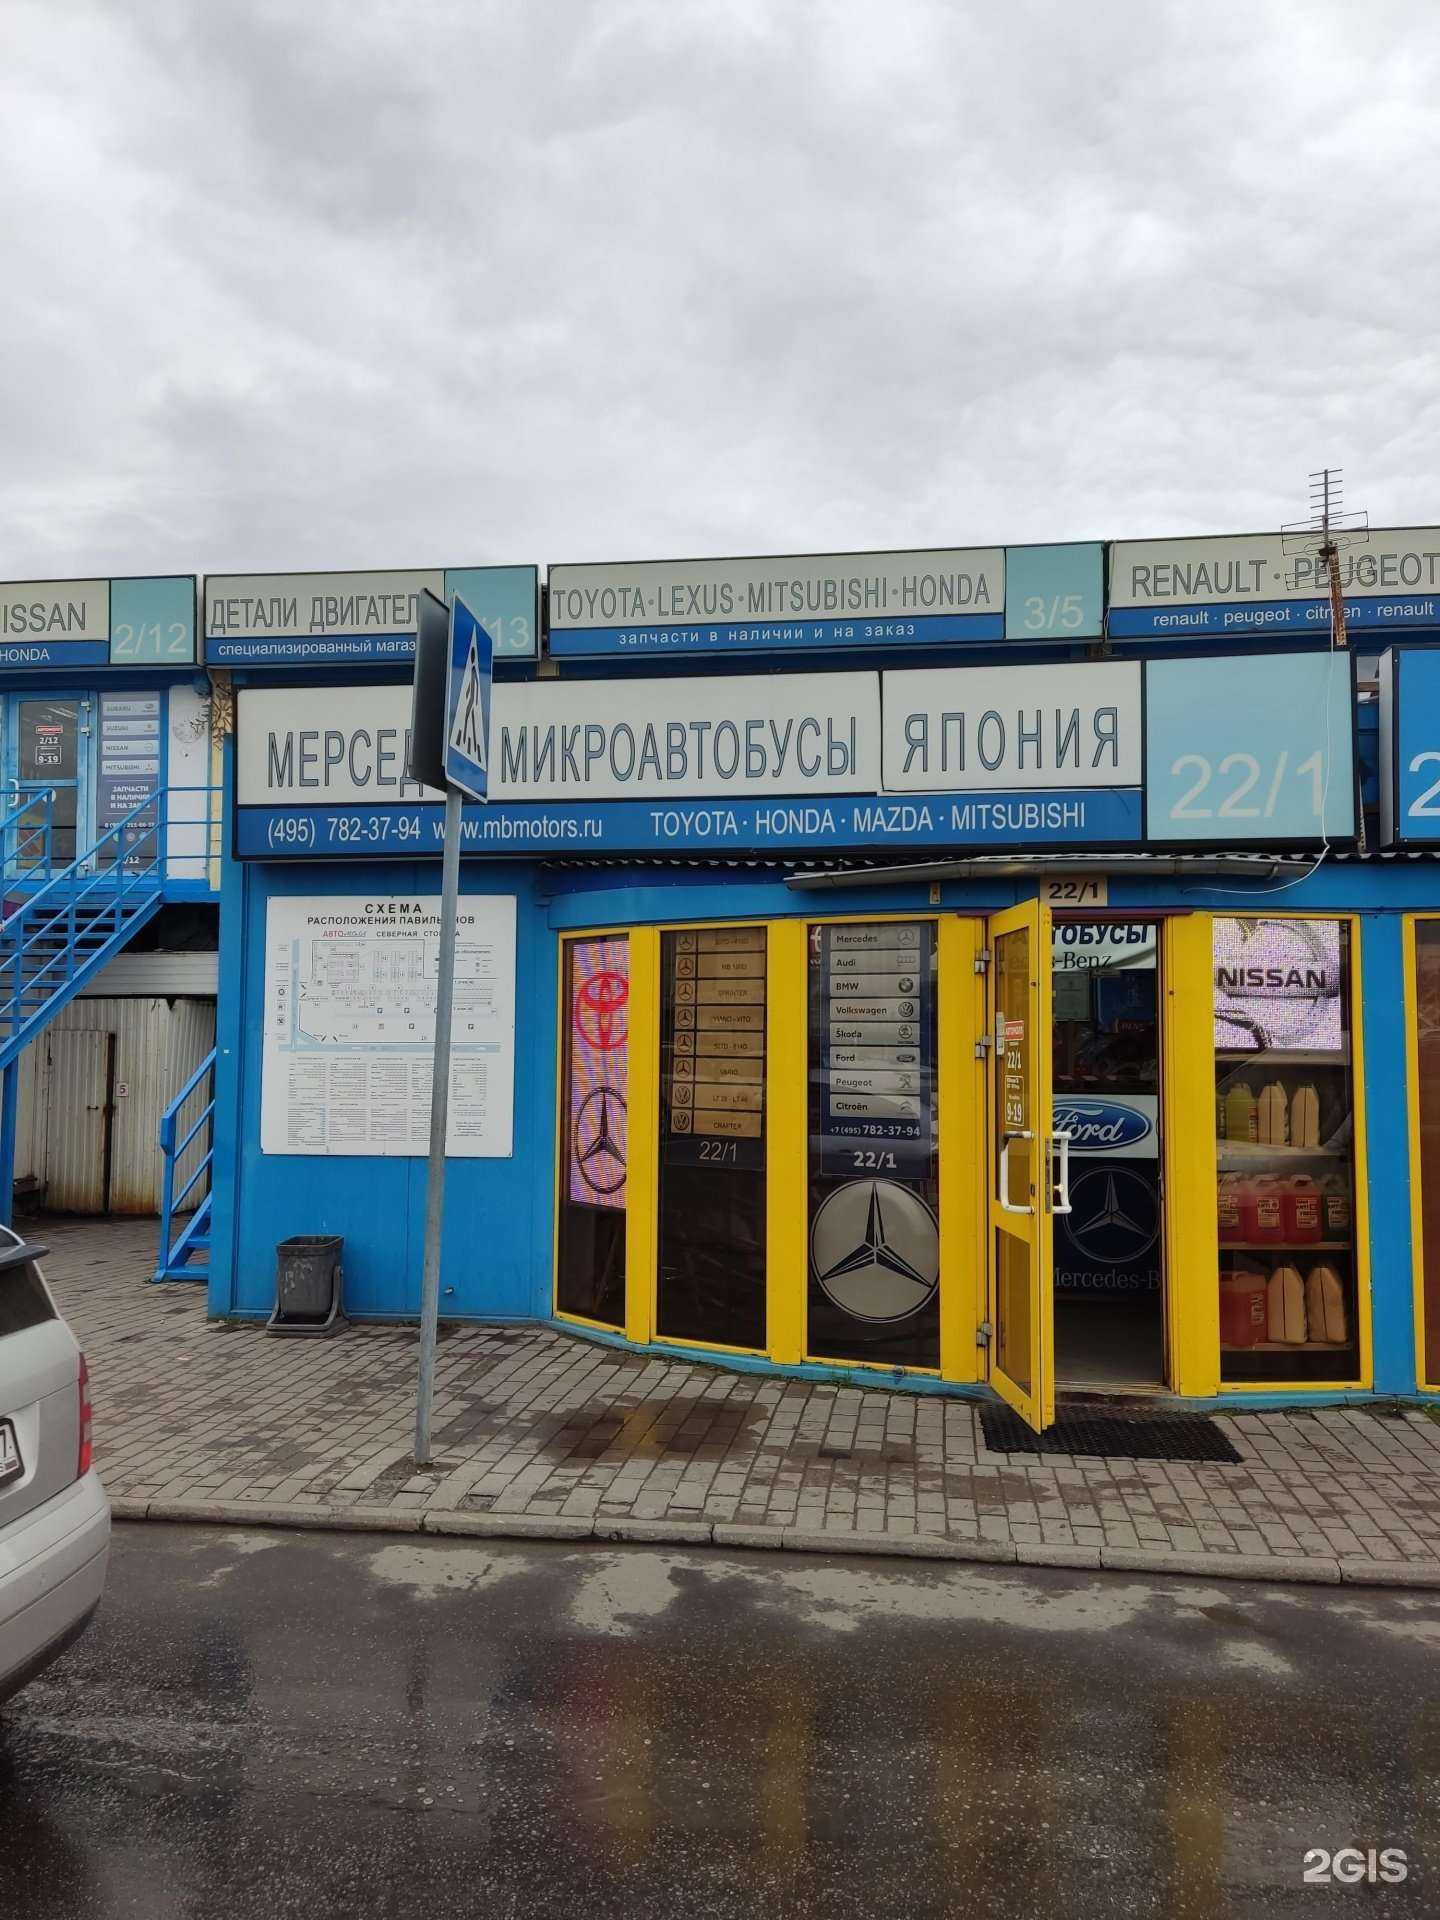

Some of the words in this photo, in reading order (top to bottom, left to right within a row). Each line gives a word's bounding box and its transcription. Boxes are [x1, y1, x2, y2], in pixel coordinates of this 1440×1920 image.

[1132, 560, 1267, 597] RENAULT
[553, 587, 646, 620] TOYOTA
[658, 583, 734, 617] LEXUS
[748, 577, 887, 613] MITSUBISHI
[902, 573, 991, 607] HONDA
[4, 602, 86, 633] ISSAN
[211, 598, 297, 635] ДЕТАЛИ
[310, 594, 419, 632] ДВИГАТЕЛ
[1024, 595, 1084, 629] 3/5
[1153, 611, 1209, 626] renault
[1224, 608, 1291, 626] peugeot
[1305, 606, 1361, 620] citren
[1377, 602, 1434, 617] renault
[114, 623, 187, 655] 2/12
[618, 632, 699, 645] запчасти
[709, 631, 718, 642] в
[728, 628, 803, 641] наличии
[814, 628, 823, 639] и
[834, 626, 854, 638] на
[864, 624, 915, 637] заказ
[0, 647, 50, 661] HONDA
[218, 639, 372, 656] специализированный
[376, 640, 416, 652] магаз
[903, 707, 1118, 773] ЯПОНИЯ
[268, 729, 424, 797] МЕРСЕД
[501, 717, 856, 783] МИКРОАВТОБУСЫ
[1170, 751, 1324, 819] 22/1
[650, 811, 738, 836] TOYOTA
[756, 808, 836, 835] HONDA
[854, 806, 934, 833] MAZDA
[952, 802, 1085, 830] MITSUBISHI
[268, 818, 316, 848] (495)
[327, 816, 421, 842] 782-37-94
[433, 815, 602, 839] ww.mbmotors.ru
[123, 856, 140, 864] /12
[1049, 881, 1098, 902] 22/1
[365, 903, 422, 914] СХЕМА
[307, 916, 396, 925] РАСПОЛОЖЕНИЯ
[400, 916, 475, 925] ПАВИЛЬОВ
[836, 934, 878, 943] Mercedes
[836, 958, 856, 967] Audi
[1052, 952, 1112, 969] -Benz
[836, 982, 860, 991] BMW
[1217, 967, 1326, 988] NISSAN
[836, 1006, 887, 1016] Volkswagen
[835, 1053, 856, 1062] Ford
[1007, 1048, 1021, 1070] 22/1
[836, 1077, 873, 1088] Peugeot
[835, 1102, 868, 1111] Citroën
[1006, 1102, 1022, 1122] 9-19
[862, 1124, 921, 1137] 782-37-94
[1053, 1107, 1125, 1141] Ford
[699, 1141, 737, 1162] 22/1
[853, 1151, 897, 1170] 22/1
